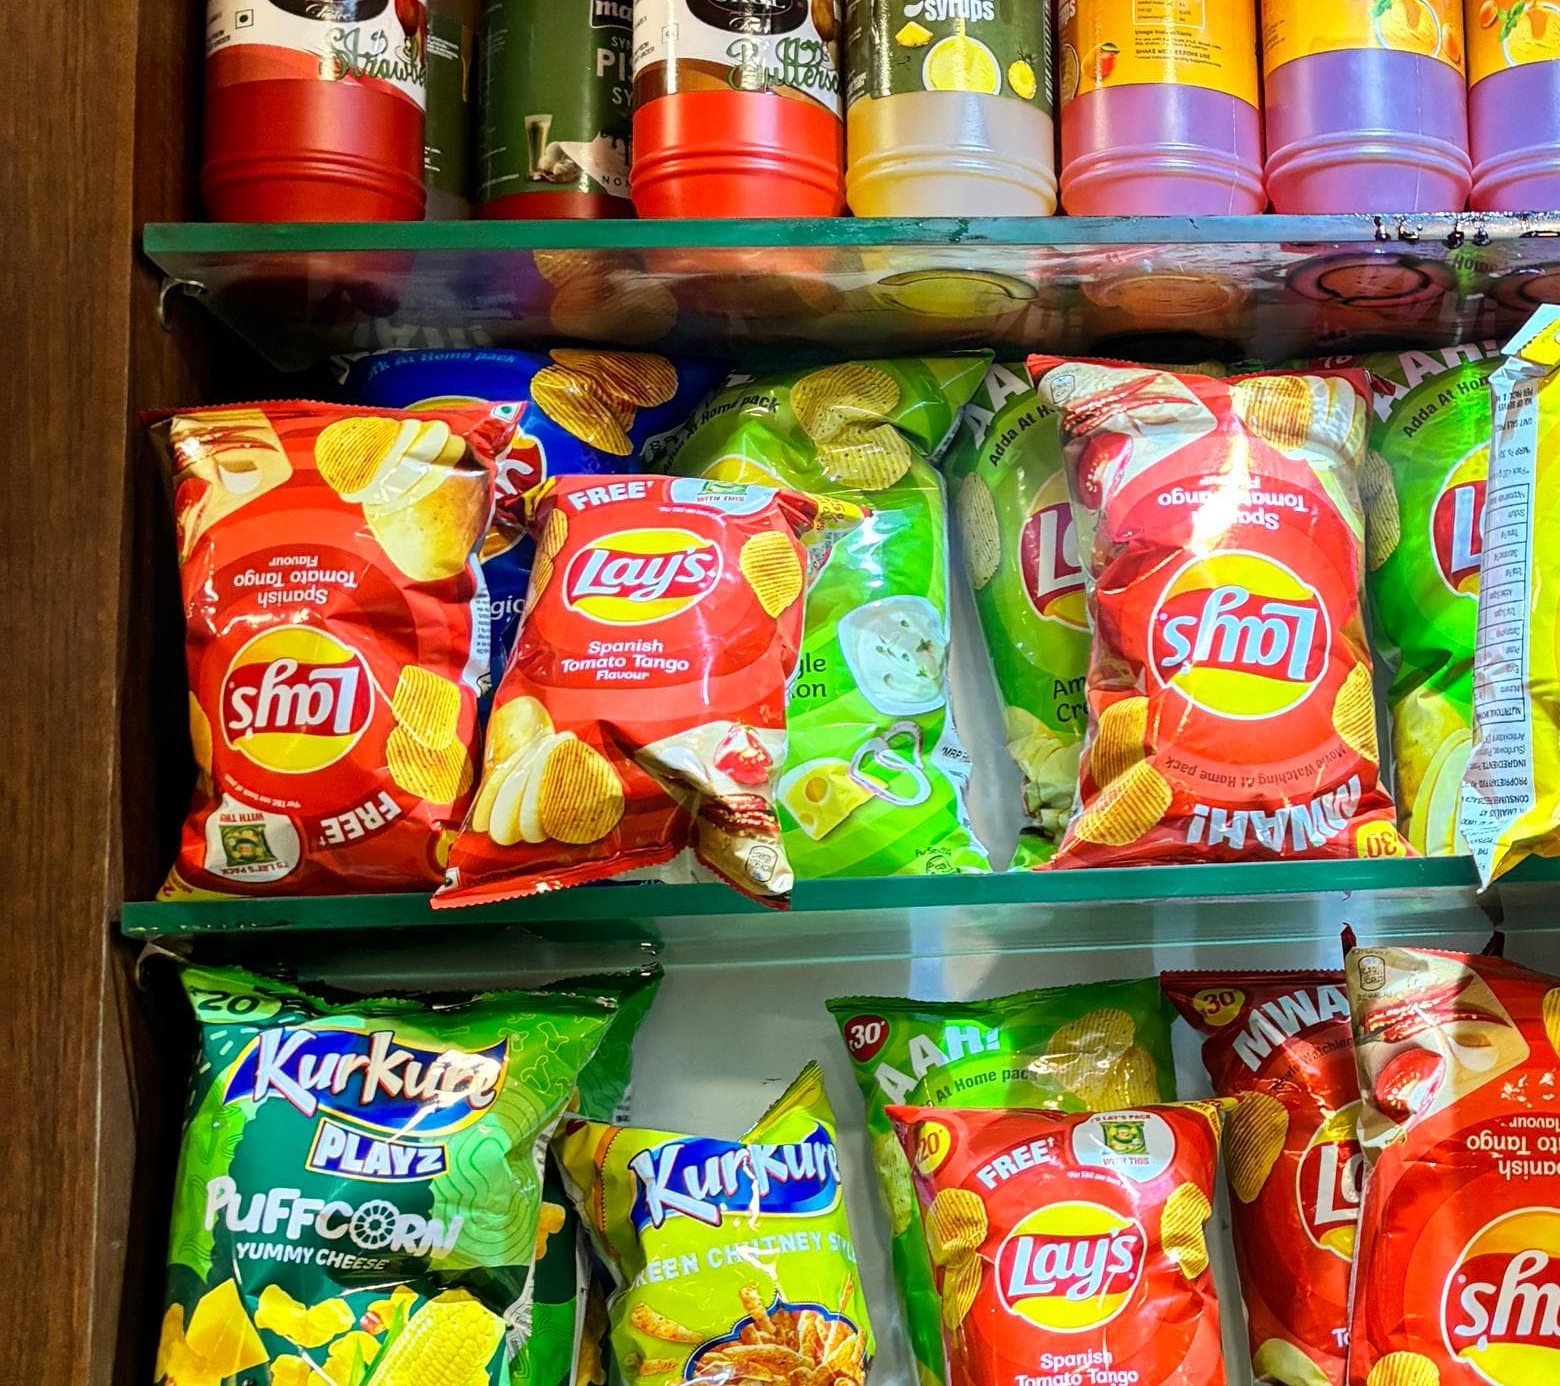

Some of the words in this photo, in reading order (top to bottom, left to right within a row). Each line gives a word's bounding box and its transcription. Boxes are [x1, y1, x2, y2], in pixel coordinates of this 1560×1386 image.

[1403, 402, 1439, 439] Adda
[1438, 389, 1456, 406] At
[987, 428, 1020, 468] Adda
[1018, 411, 1037, 433] At
[268, 555, 318, 568] Flavour
[233, 570, 286, 589] Tango
[297, 569, 358, 588] Tomato
[571, 548, 714, 602] Lay's
[257, 588, 328, 607] Spanish
[1160, 585, 1318, 681] Lay's
[588, 639, 664, 656] Spanish
[561, 655, 627, 673] Tomato
[632, 654, 690, 673] Tango
[595, 669, 650, 681] Flavour
[229, 660, 357, 740] Lay's
[1165, 756, 1199, 777] pack
[1199, 769, 1238, 788] Home
[1258, 763, 1316, 786] Watching
[1187, 774, 1361, 852] MWAH!
[874, 1025, 1001, 1106] AAH!
[953, 1070, 998, 1093] Home
[313, 1127, 446, 1176] PLAYZ
[1465, 1133, 1532, 1158] Tango
[235, 1241, 314, 1265] YUMMY
[316, 1247, 390, 1273] CHEESE
[706, 1231, 823, 1270] CHUTNEY
[1007, 1227, 1138, 1301] Lay's
[1040, 1348, 1113, 1373] Spanish
